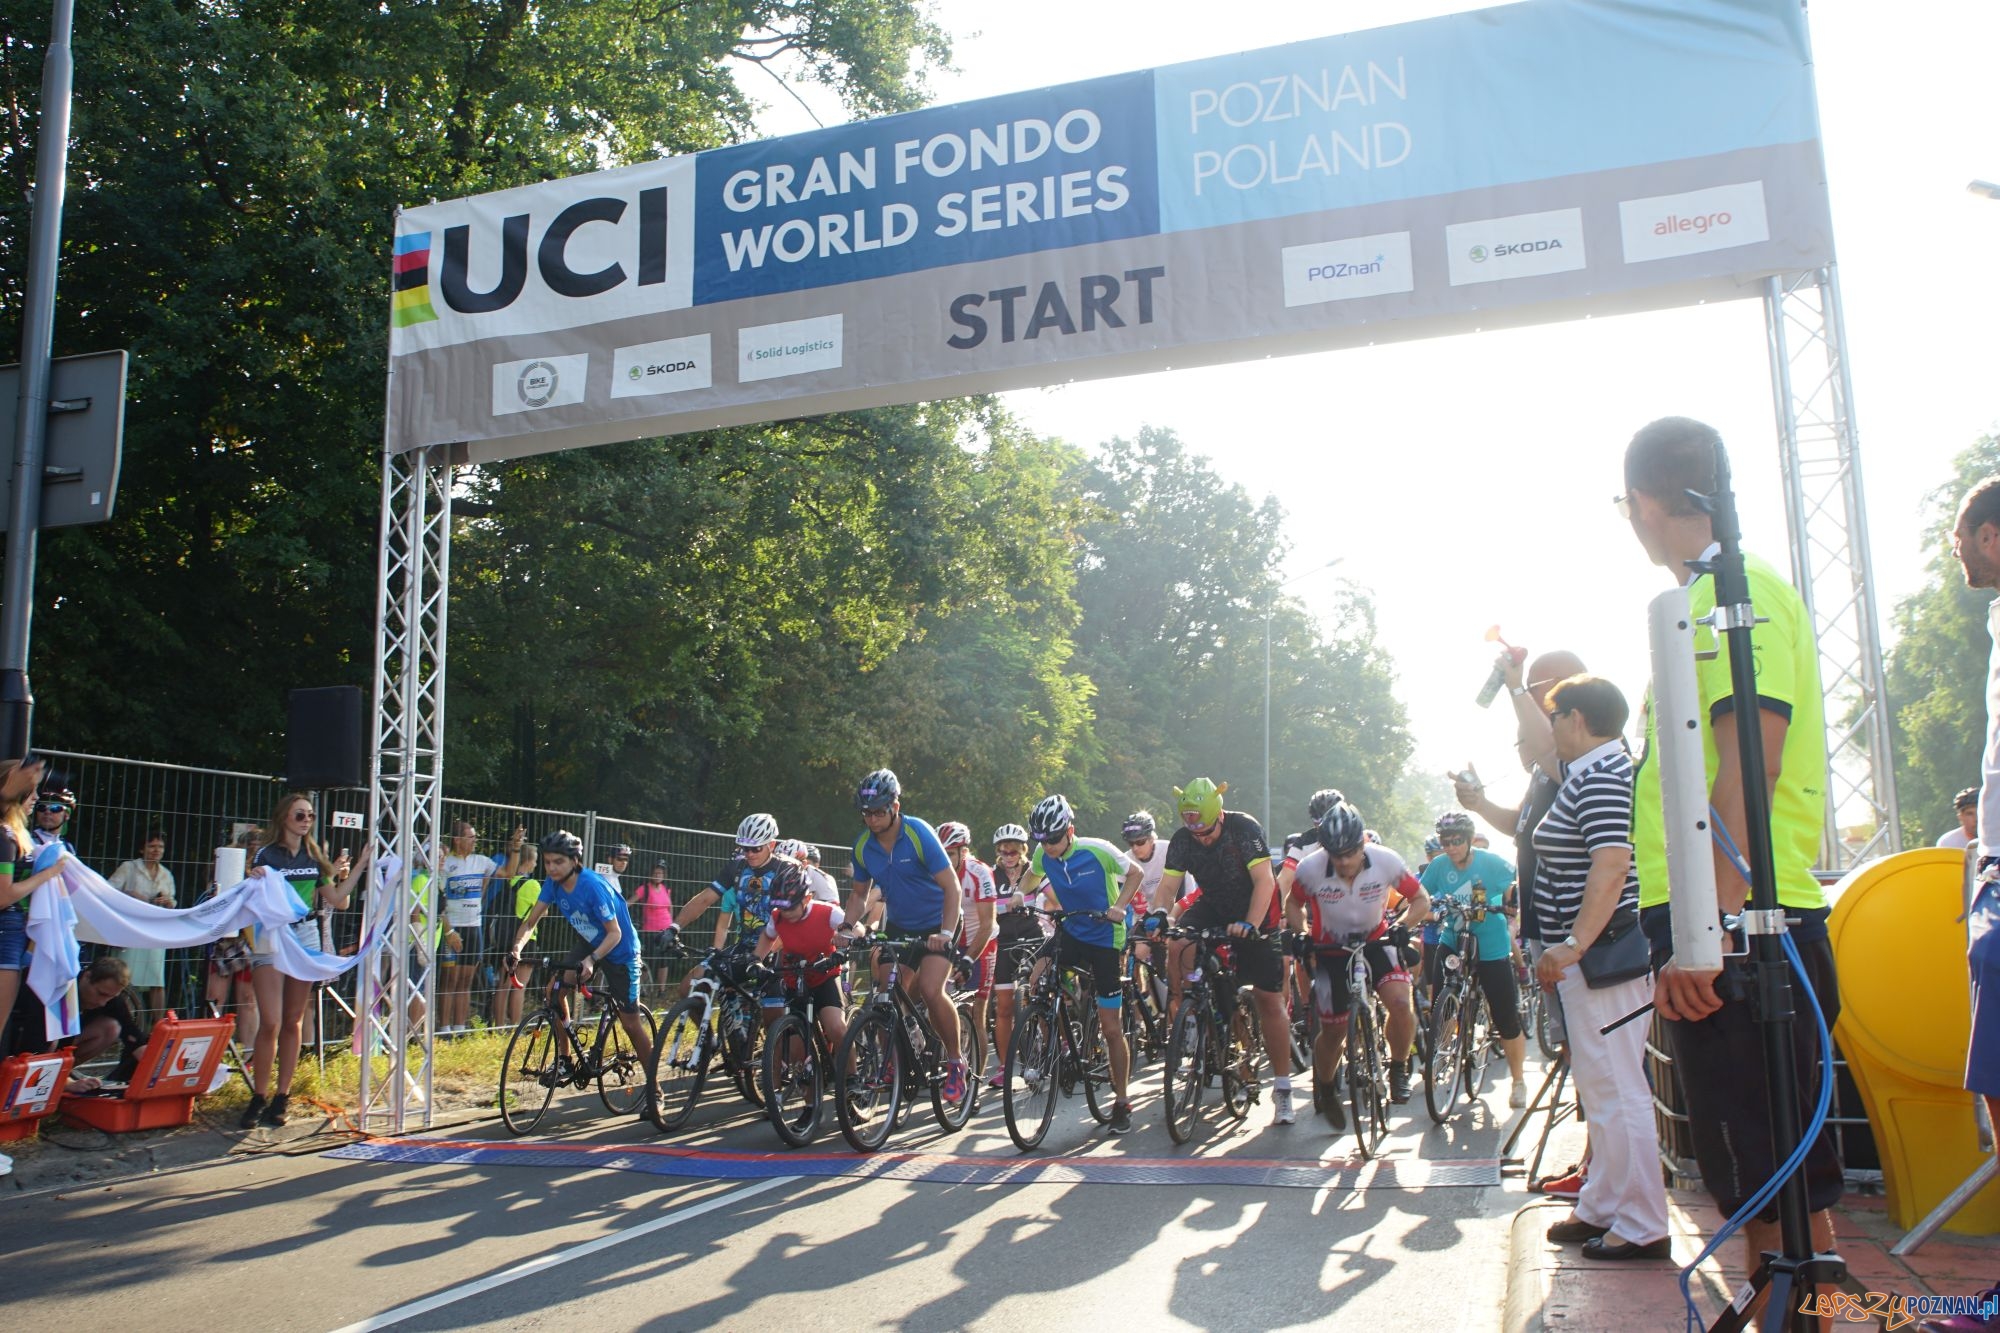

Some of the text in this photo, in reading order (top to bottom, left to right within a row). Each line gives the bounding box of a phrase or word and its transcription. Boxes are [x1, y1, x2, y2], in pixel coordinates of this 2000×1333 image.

[1189, 56, 1407, 134] POZNAN
[722, 109, 1101, 213] GRAN FONDO
[1193, 121, 1412, 196] POLAND
[720, 165, 1130, 272] WORLD SERIES
[1653, 210, 1732, 237] allegro
[440, 186, 667, 314] UCI
[1494, 238, 1562, 258] ŠKODA
[946, 265, 1165, 350] START
[646, 360, 696, 376] ŠKODA
[755, 340, 834, 360] Solid Logistics
[529, 377, 546, 386] BIKE
[338, 816, 357, 827] TFS
